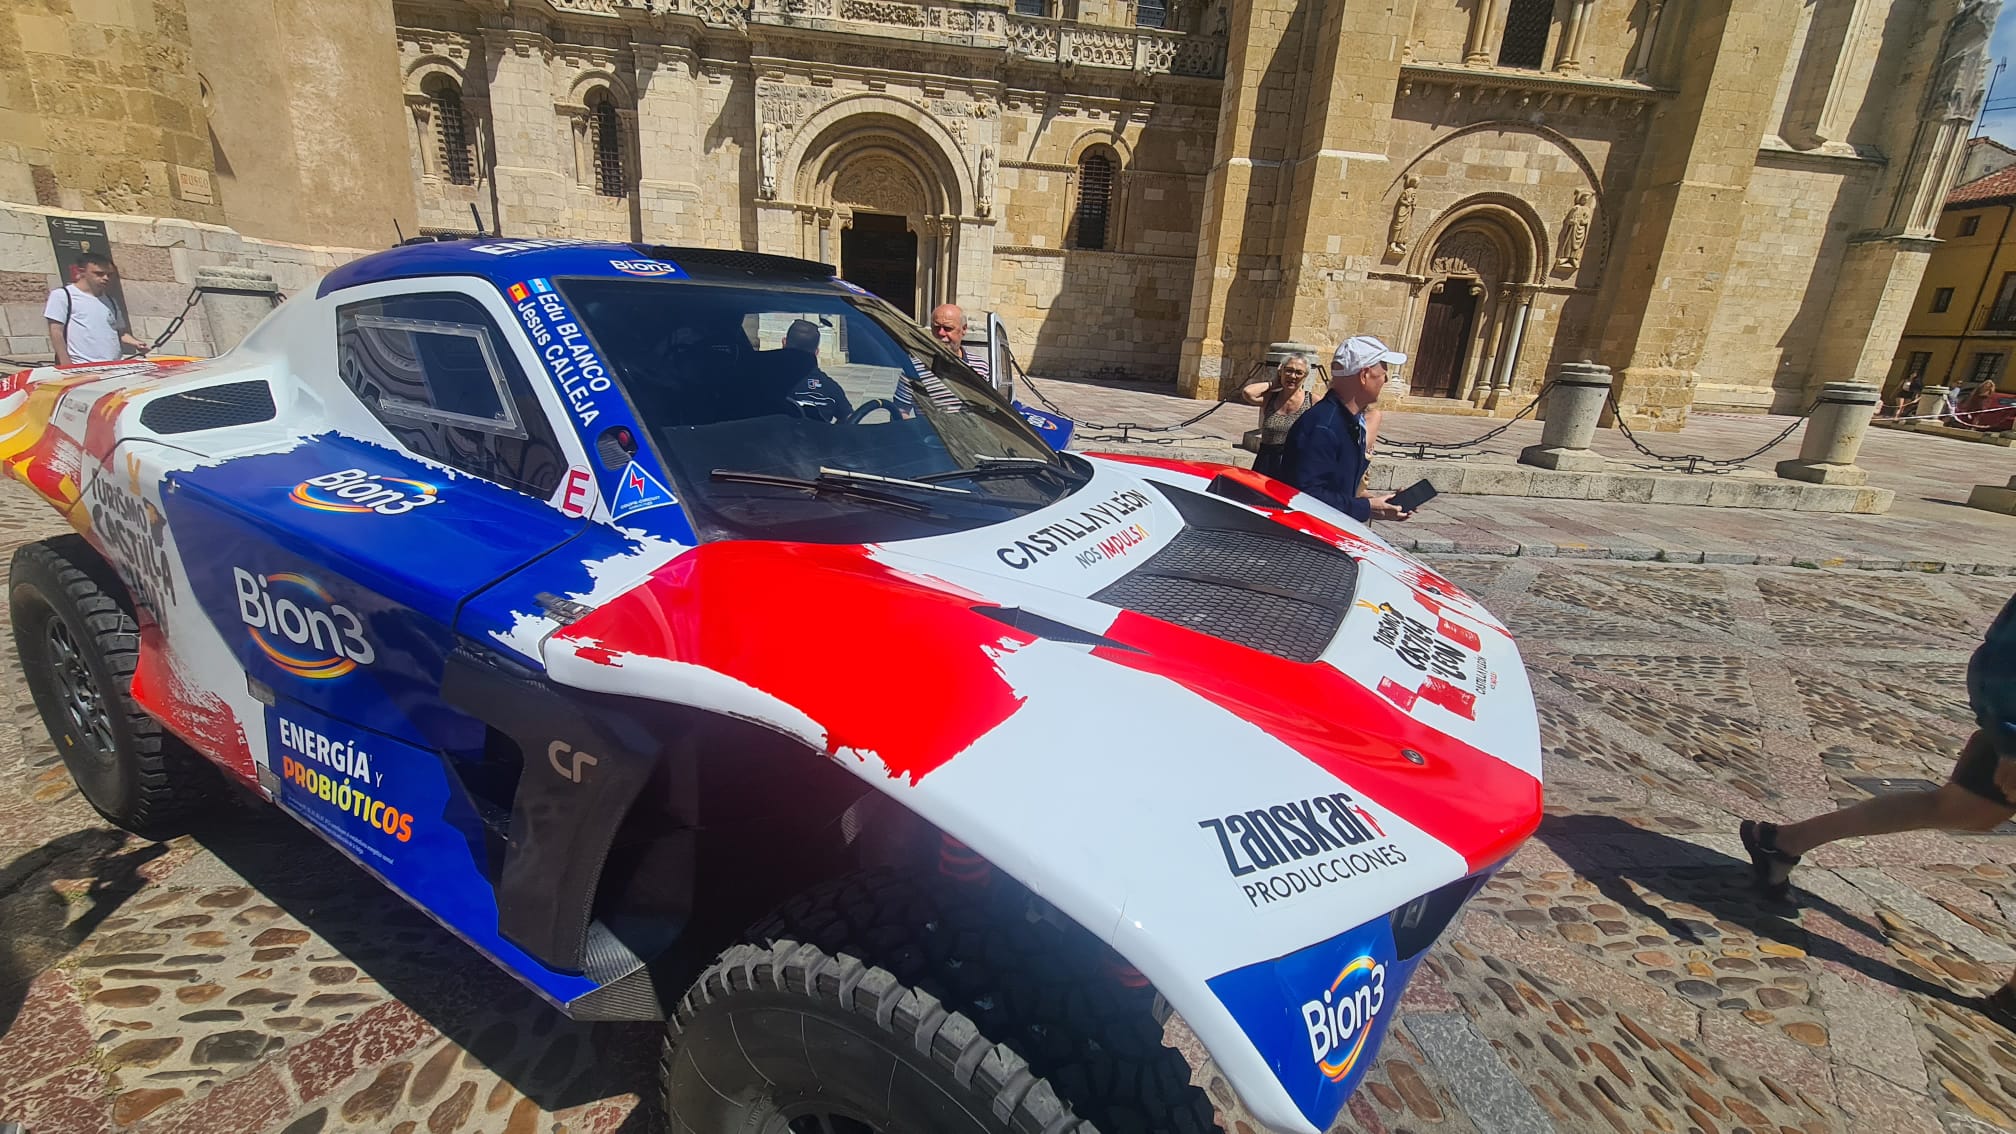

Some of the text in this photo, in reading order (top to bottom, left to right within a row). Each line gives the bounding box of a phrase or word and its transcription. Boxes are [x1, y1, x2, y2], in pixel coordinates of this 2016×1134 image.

[609, 260, 676, 273] Bion3
[518, 301, 600, 428] Jesus CALLEJA
[537, 292, 612, 392] Edu BLANCO
[304, 468, 437, 515] Bion3
[562, 469, 590, 514] E
[996, 489, 1152, 570] CASTILLA Y LEÓN
[1075, 523, 1150, 569] NOS IMPULSA
[233, 566, 376, 665] Bion3
[1373, 612, 1401, 650] TURISMO
[1395, 616, 1436, 671] CASTILLA
[279, 717, 384, 788] ENERGÍA Y
[282, 755, 414, 843] PROBIÓTICOS
[1243, 844, 1407, 907] PRODUCCIONES
[1301, 964, 1385, 1064] Bion3
